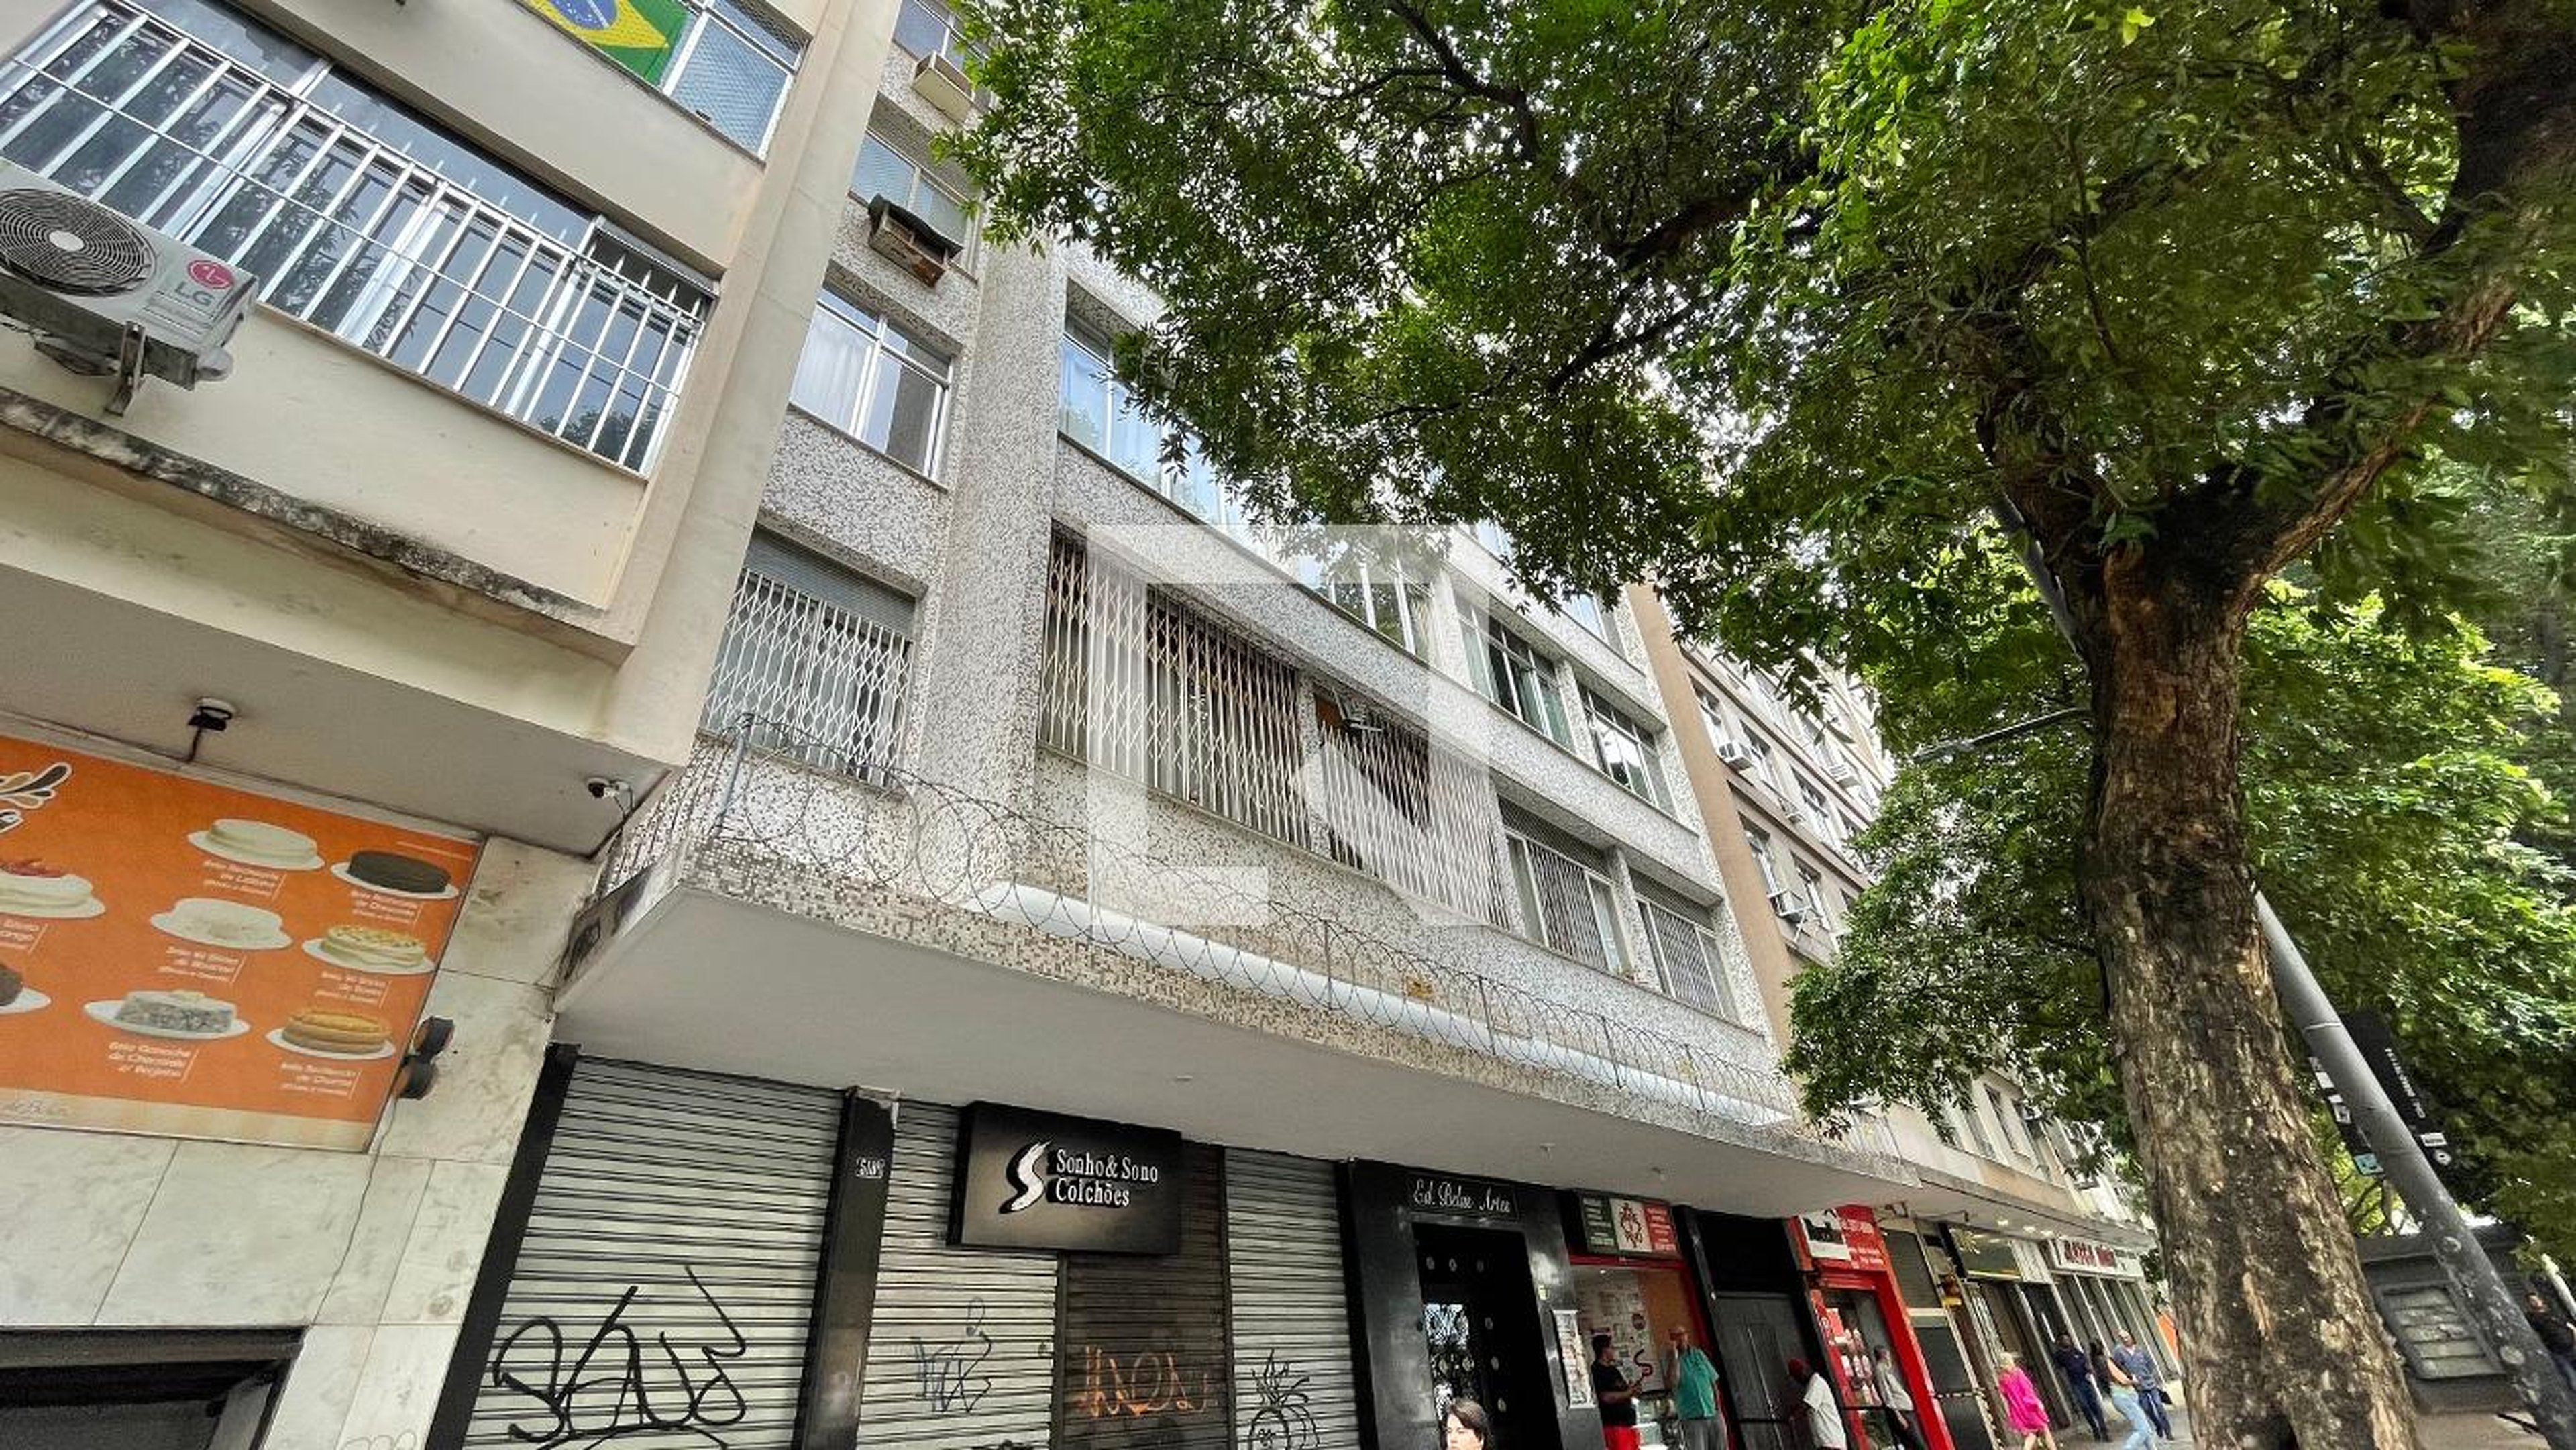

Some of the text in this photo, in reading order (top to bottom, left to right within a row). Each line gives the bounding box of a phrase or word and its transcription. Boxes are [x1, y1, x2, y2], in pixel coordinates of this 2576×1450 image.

[175, 281, 215, 307] LG
[1121, 1157, 1158, 1182] Sono
[1055, 1178, 1130, 1206] Colchões
[1413, 1178, 1436, 1206] Ed.
